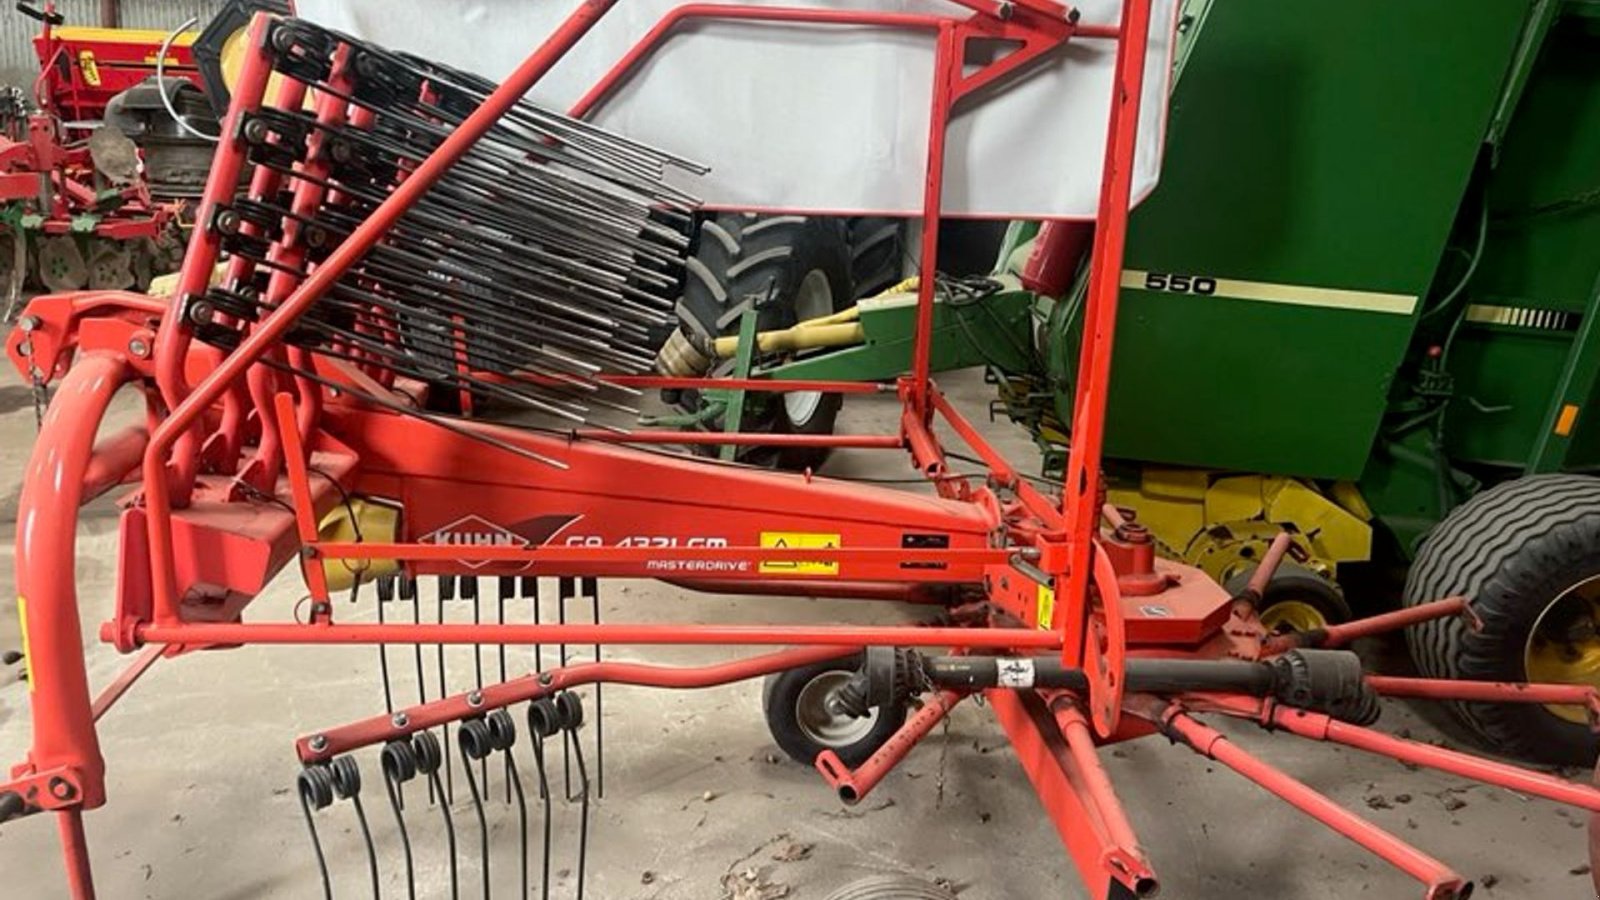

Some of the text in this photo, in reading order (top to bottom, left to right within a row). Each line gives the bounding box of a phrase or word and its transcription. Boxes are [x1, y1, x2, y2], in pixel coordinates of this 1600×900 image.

[1145, 273, 1217, 295] 550
[435, 531, 513, 546] KUHN
[646, 559, 748, 571] MASTERDRIVE
